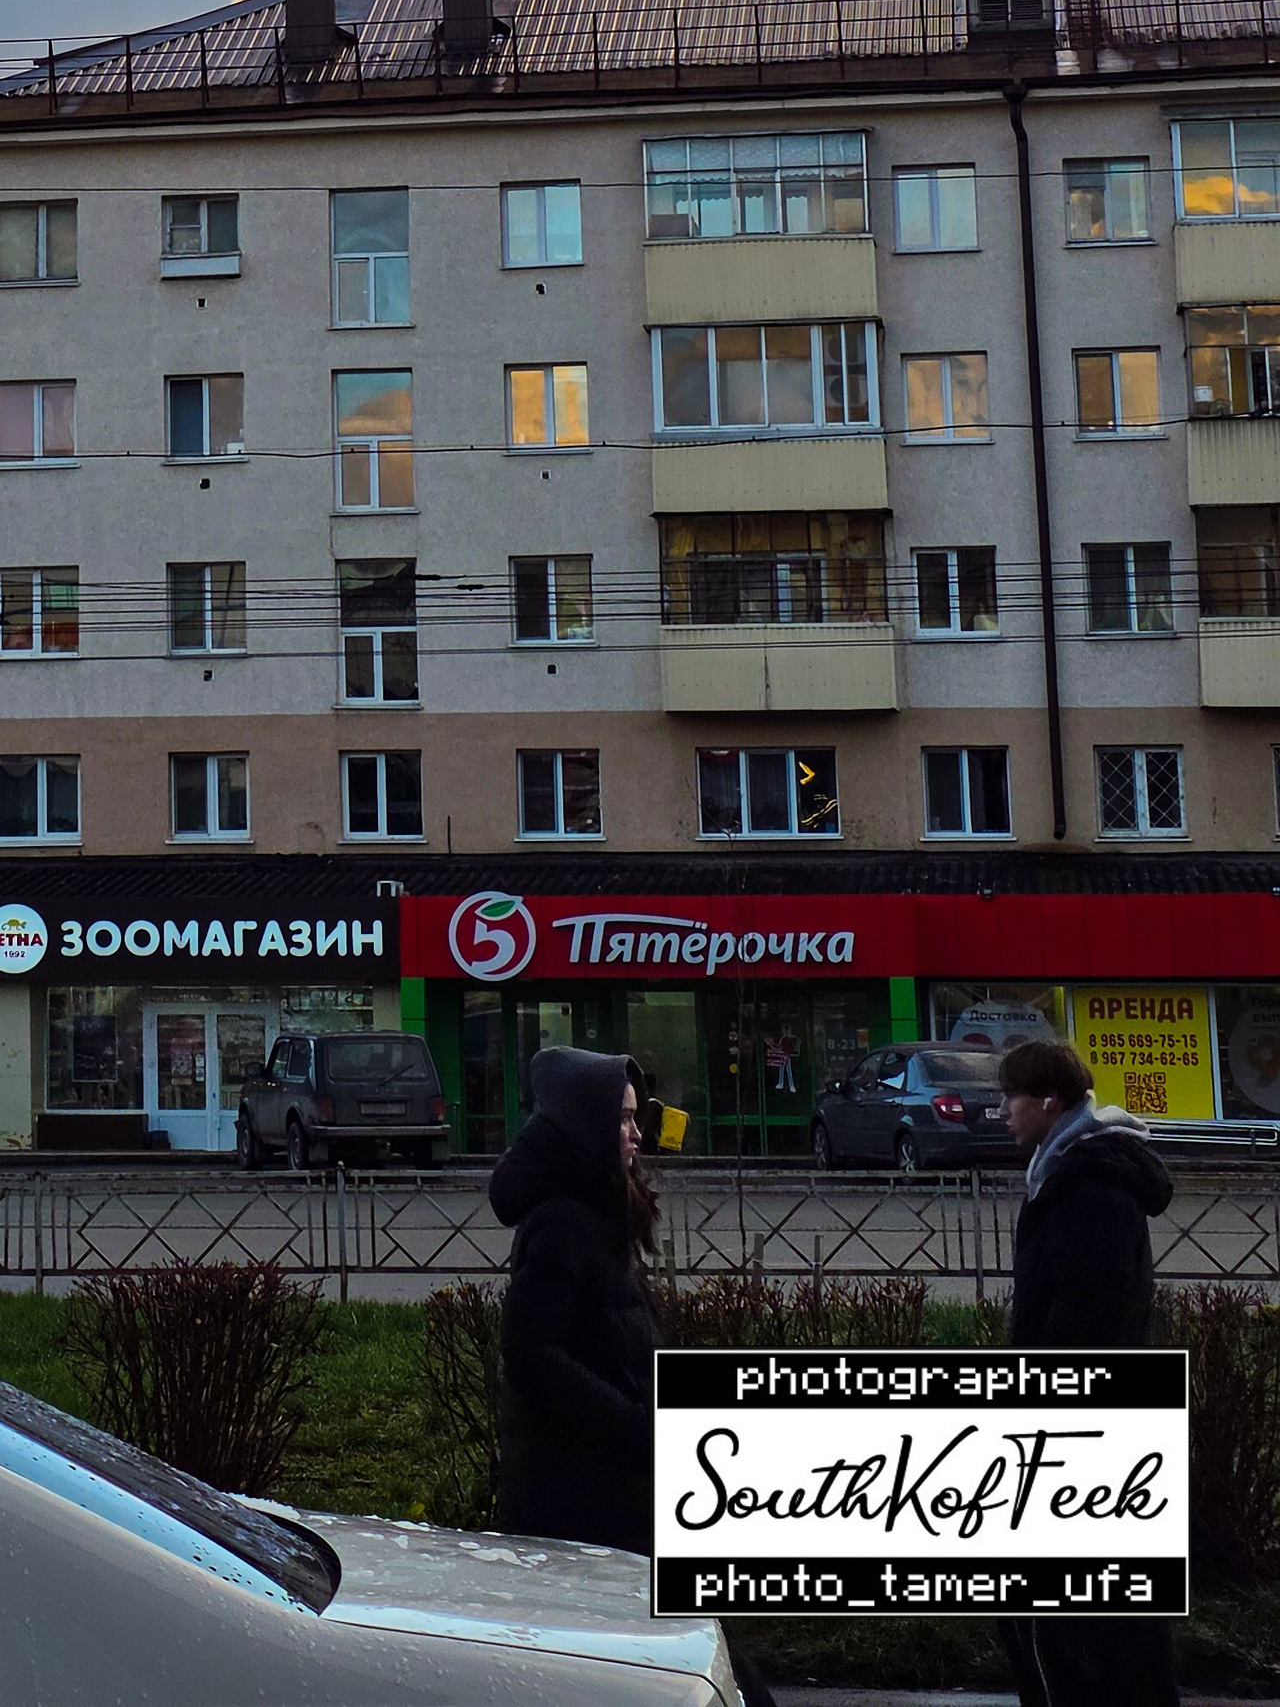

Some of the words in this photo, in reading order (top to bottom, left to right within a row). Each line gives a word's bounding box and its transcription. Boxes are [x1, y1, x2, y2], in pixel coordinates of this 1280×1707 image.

[60, 919, 383, 957] ЗООМАГАЗИН
[470, 918, 516, 970] 5
[552, 913, 855, 976] Пятёрочка
[969, 1010, 1037, 1022] Доставка
[1089, 997, 1194, 1024] АРЕНДА
[1089, 1034, 1097, 1047] 8
[1128, 1034, 1198, 1049] 669-75-15
[1090, 1051, 1098, 1065] 8
[1102, 1052, 1126, 1065] 967
